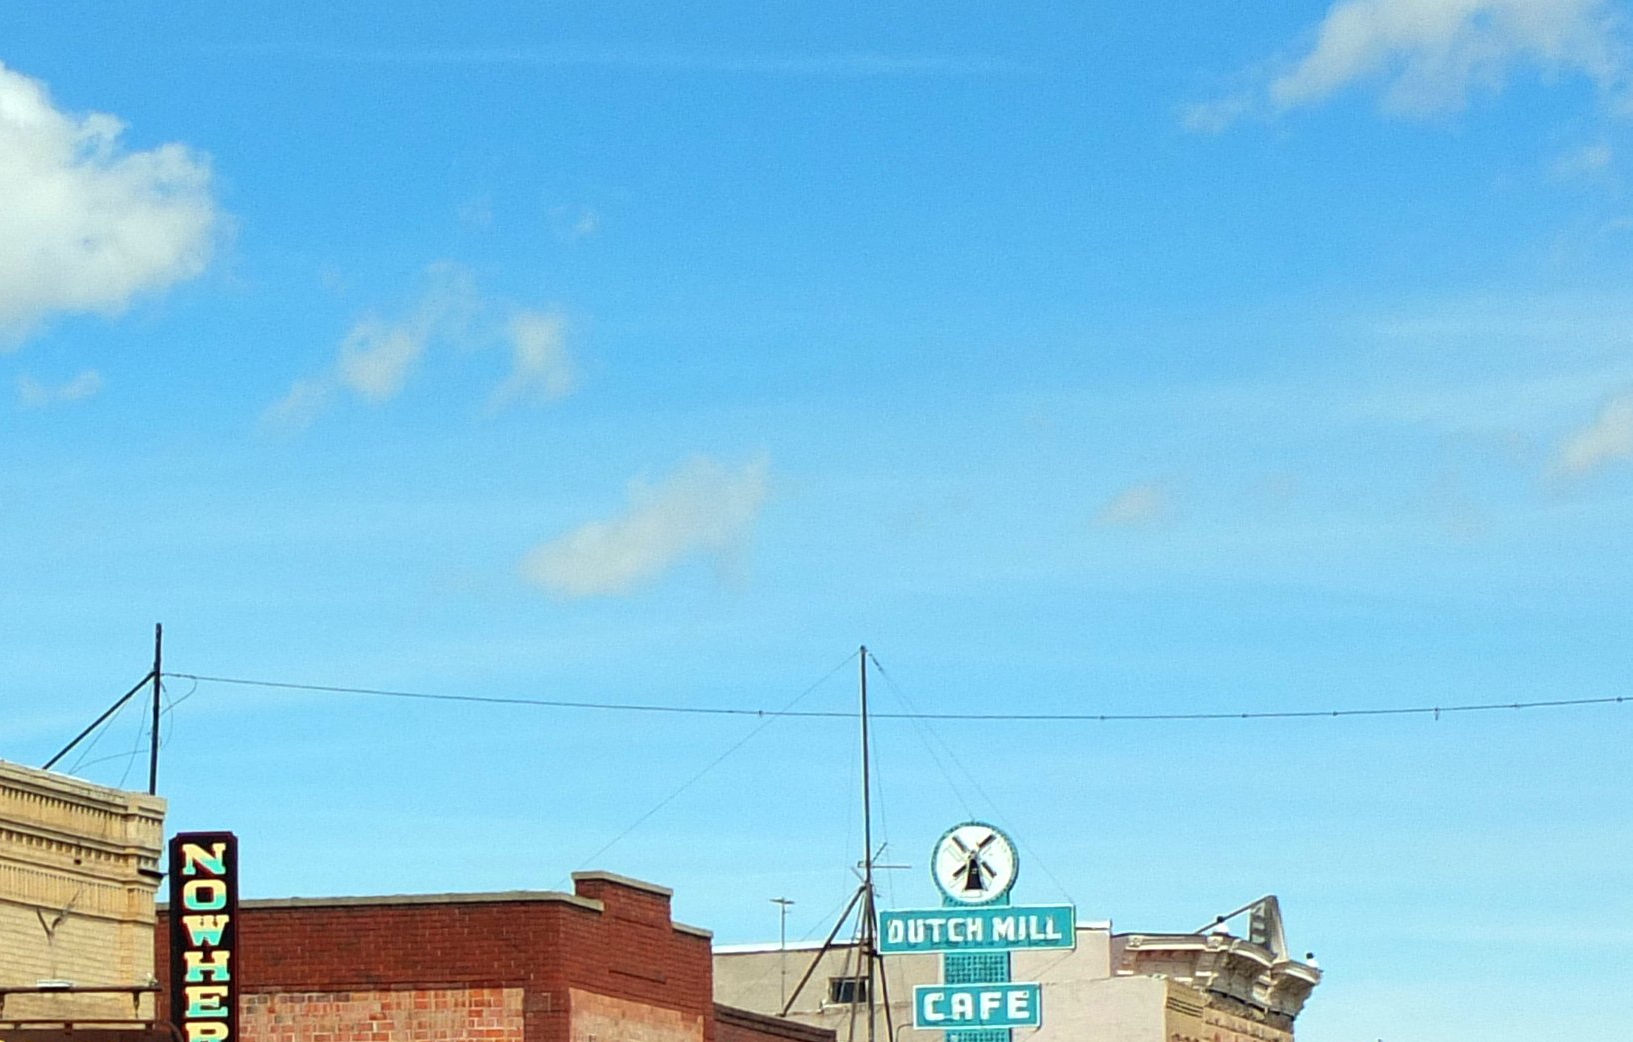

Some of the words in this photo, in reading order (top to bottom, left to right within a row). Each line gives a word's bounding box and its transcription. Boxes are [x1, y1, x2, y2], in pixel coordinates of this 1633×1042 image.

[887, 918, 982, 945] DUTCH
[992, 914, 1063, 942] MILL
[923, 989, 1031, 1021] CAFE
